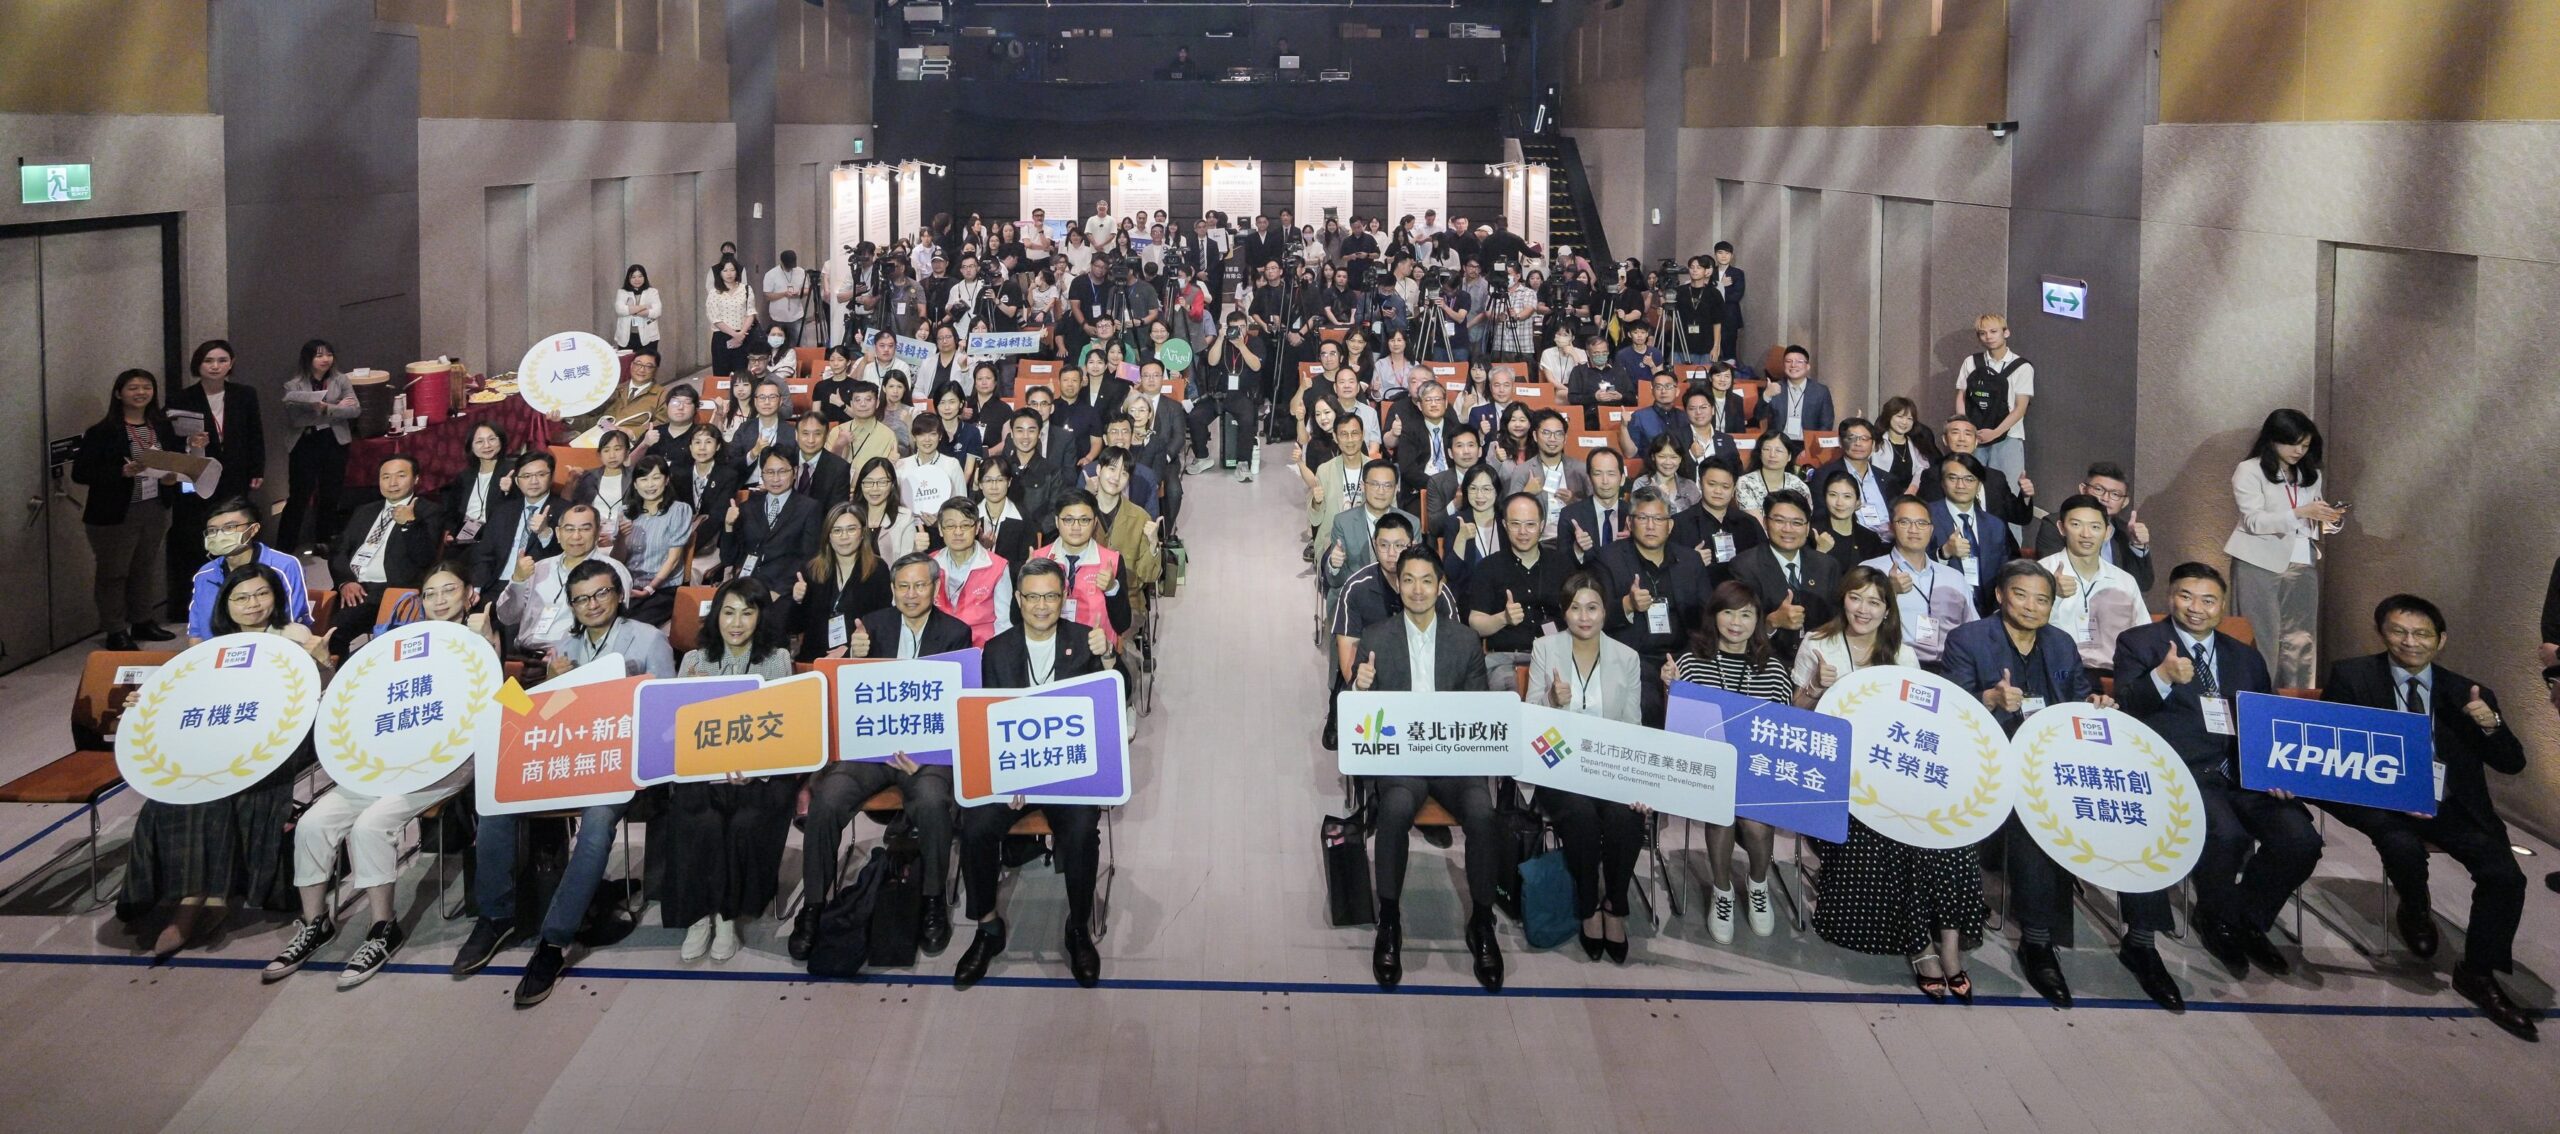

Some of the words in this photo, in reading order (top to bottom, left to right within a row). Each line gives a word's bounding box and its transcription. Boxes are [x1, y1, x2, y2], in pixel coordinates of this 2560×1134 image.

[1162, 347, 1191, 364] Angel
[550, 364, 591, 383] 人氣獎
[915, 487, 938, 498] Amo
[226, 650, 247, 658] TOPS
[403, 640, 423, 649] TOPS
[387, 674, 433, 705] 採購
[854, 680, 944, 705] 台北夠好
[1910, 687, 1932, 699] TOPS
[179, 701, 259, 730] 商機獎
[374, 700, 444, 737] 貢獻獎
[693, 710, 784, 750] 促成交
[855, 712, 945, 737] 台北好購
[996, 714, 1085, 743] TOPS
[2081, 722, 2103, 731] TOPS
[523, 713, 632, 751] 中小+新創
[1406, 721, 1508, 742] 臺北市政府
[1750, 716, 1839, 763] 拚採購
[1887, 720, 1941, 756] 永續
[998, 743, 1087, 771] 台北好購
[1352, 743, 1400, 756] TAIPEI
[1408, 743, 1433, 754] Taipei
[1435, 743, 1452, 754] City
[1453, 743, 1509, 753] Government
[1580, 739, 1717, 779] 臺北市政府產業發展局
[2267, 741, 2400, 785] KPMG
[521, 748, 622, 785] 商機無限
[1580, 755, 1621, 771] Department
[1622, 765, 1630, 773] of
[1631, 767, 1666, 781] Economic
[1667, 774, 1715, 791] Development
[1580, 764, 1600, 775] Taipei
[1602, 769, 1616, 780] City
[1617, 773, 1661, 788] Government
[1748, 753, 1827, 793] 拿獎金
[1868, 743, 1950, 789] 共榮獎
[2053, 762, 2153, 795] 採購新創
[2071, 796, 2148, 827] 貢獻獎
